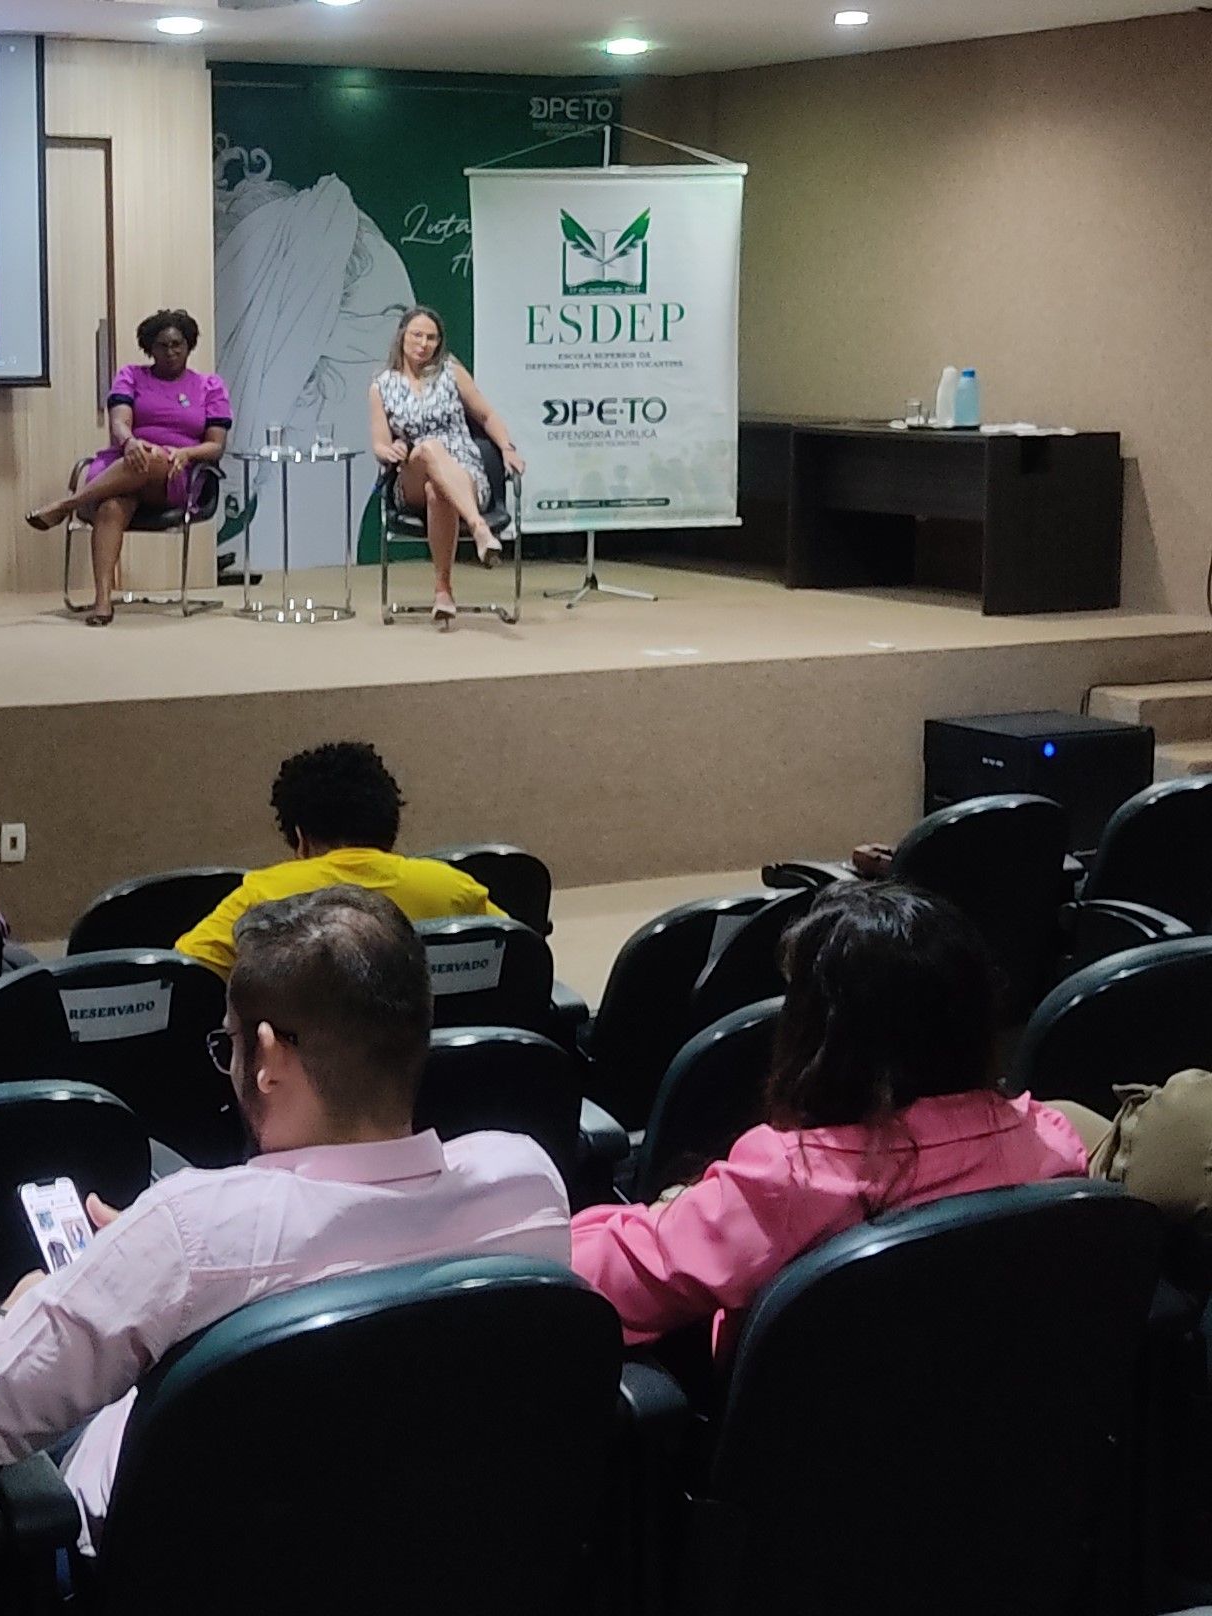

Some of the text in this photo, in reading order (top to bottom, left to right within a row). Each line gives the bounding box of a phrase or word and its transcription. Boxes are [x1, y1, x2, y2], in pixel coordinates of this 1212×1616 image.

[525, 302, 685, 345] ESDEP
[547, 430, 611, 441] DEFENSORIA
[430, 959, 489, 975] SERVADO
[68, 1000, 156, 1020] RESERVADO
